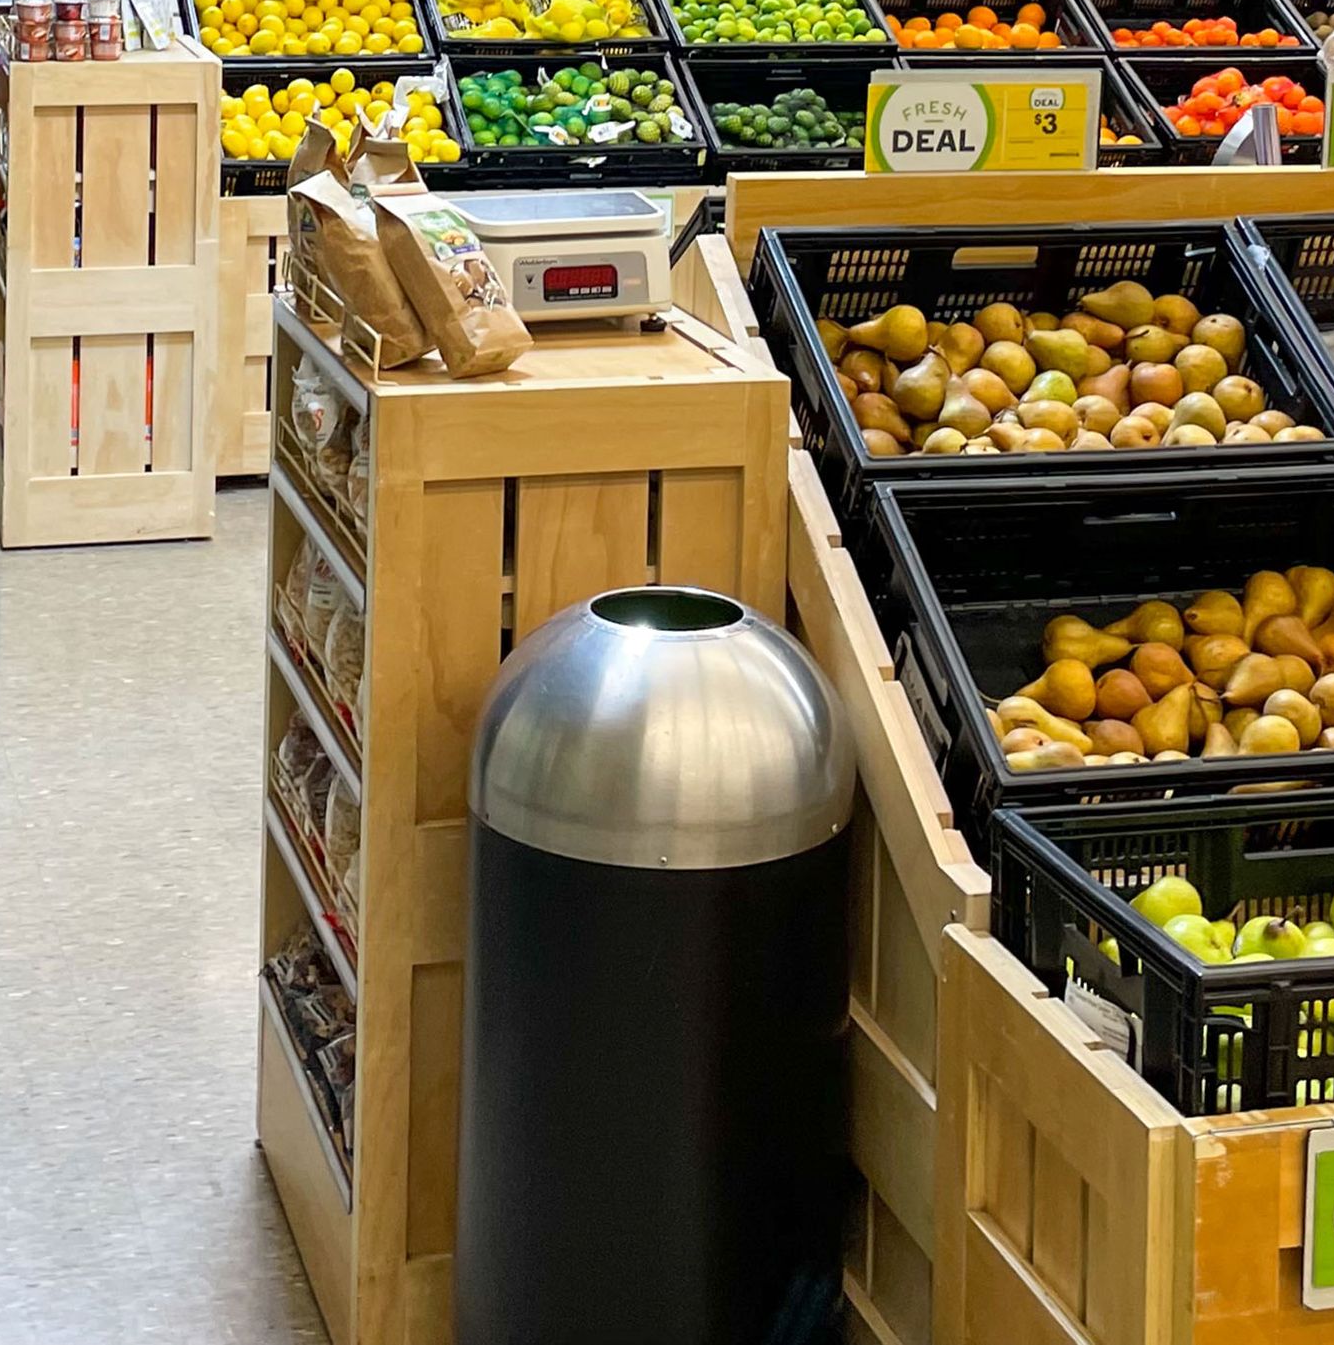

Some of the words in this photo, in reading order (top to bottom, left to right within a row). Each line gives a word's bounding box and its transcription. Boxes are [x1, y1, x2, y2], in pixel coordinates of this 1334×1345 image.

[901, 100, 969, 123] FRESH
[1033, 99, 1060, 108] DEAL
[1034, 113, 1058, 135] $3
[892, 129, 976, 153] DEAL
